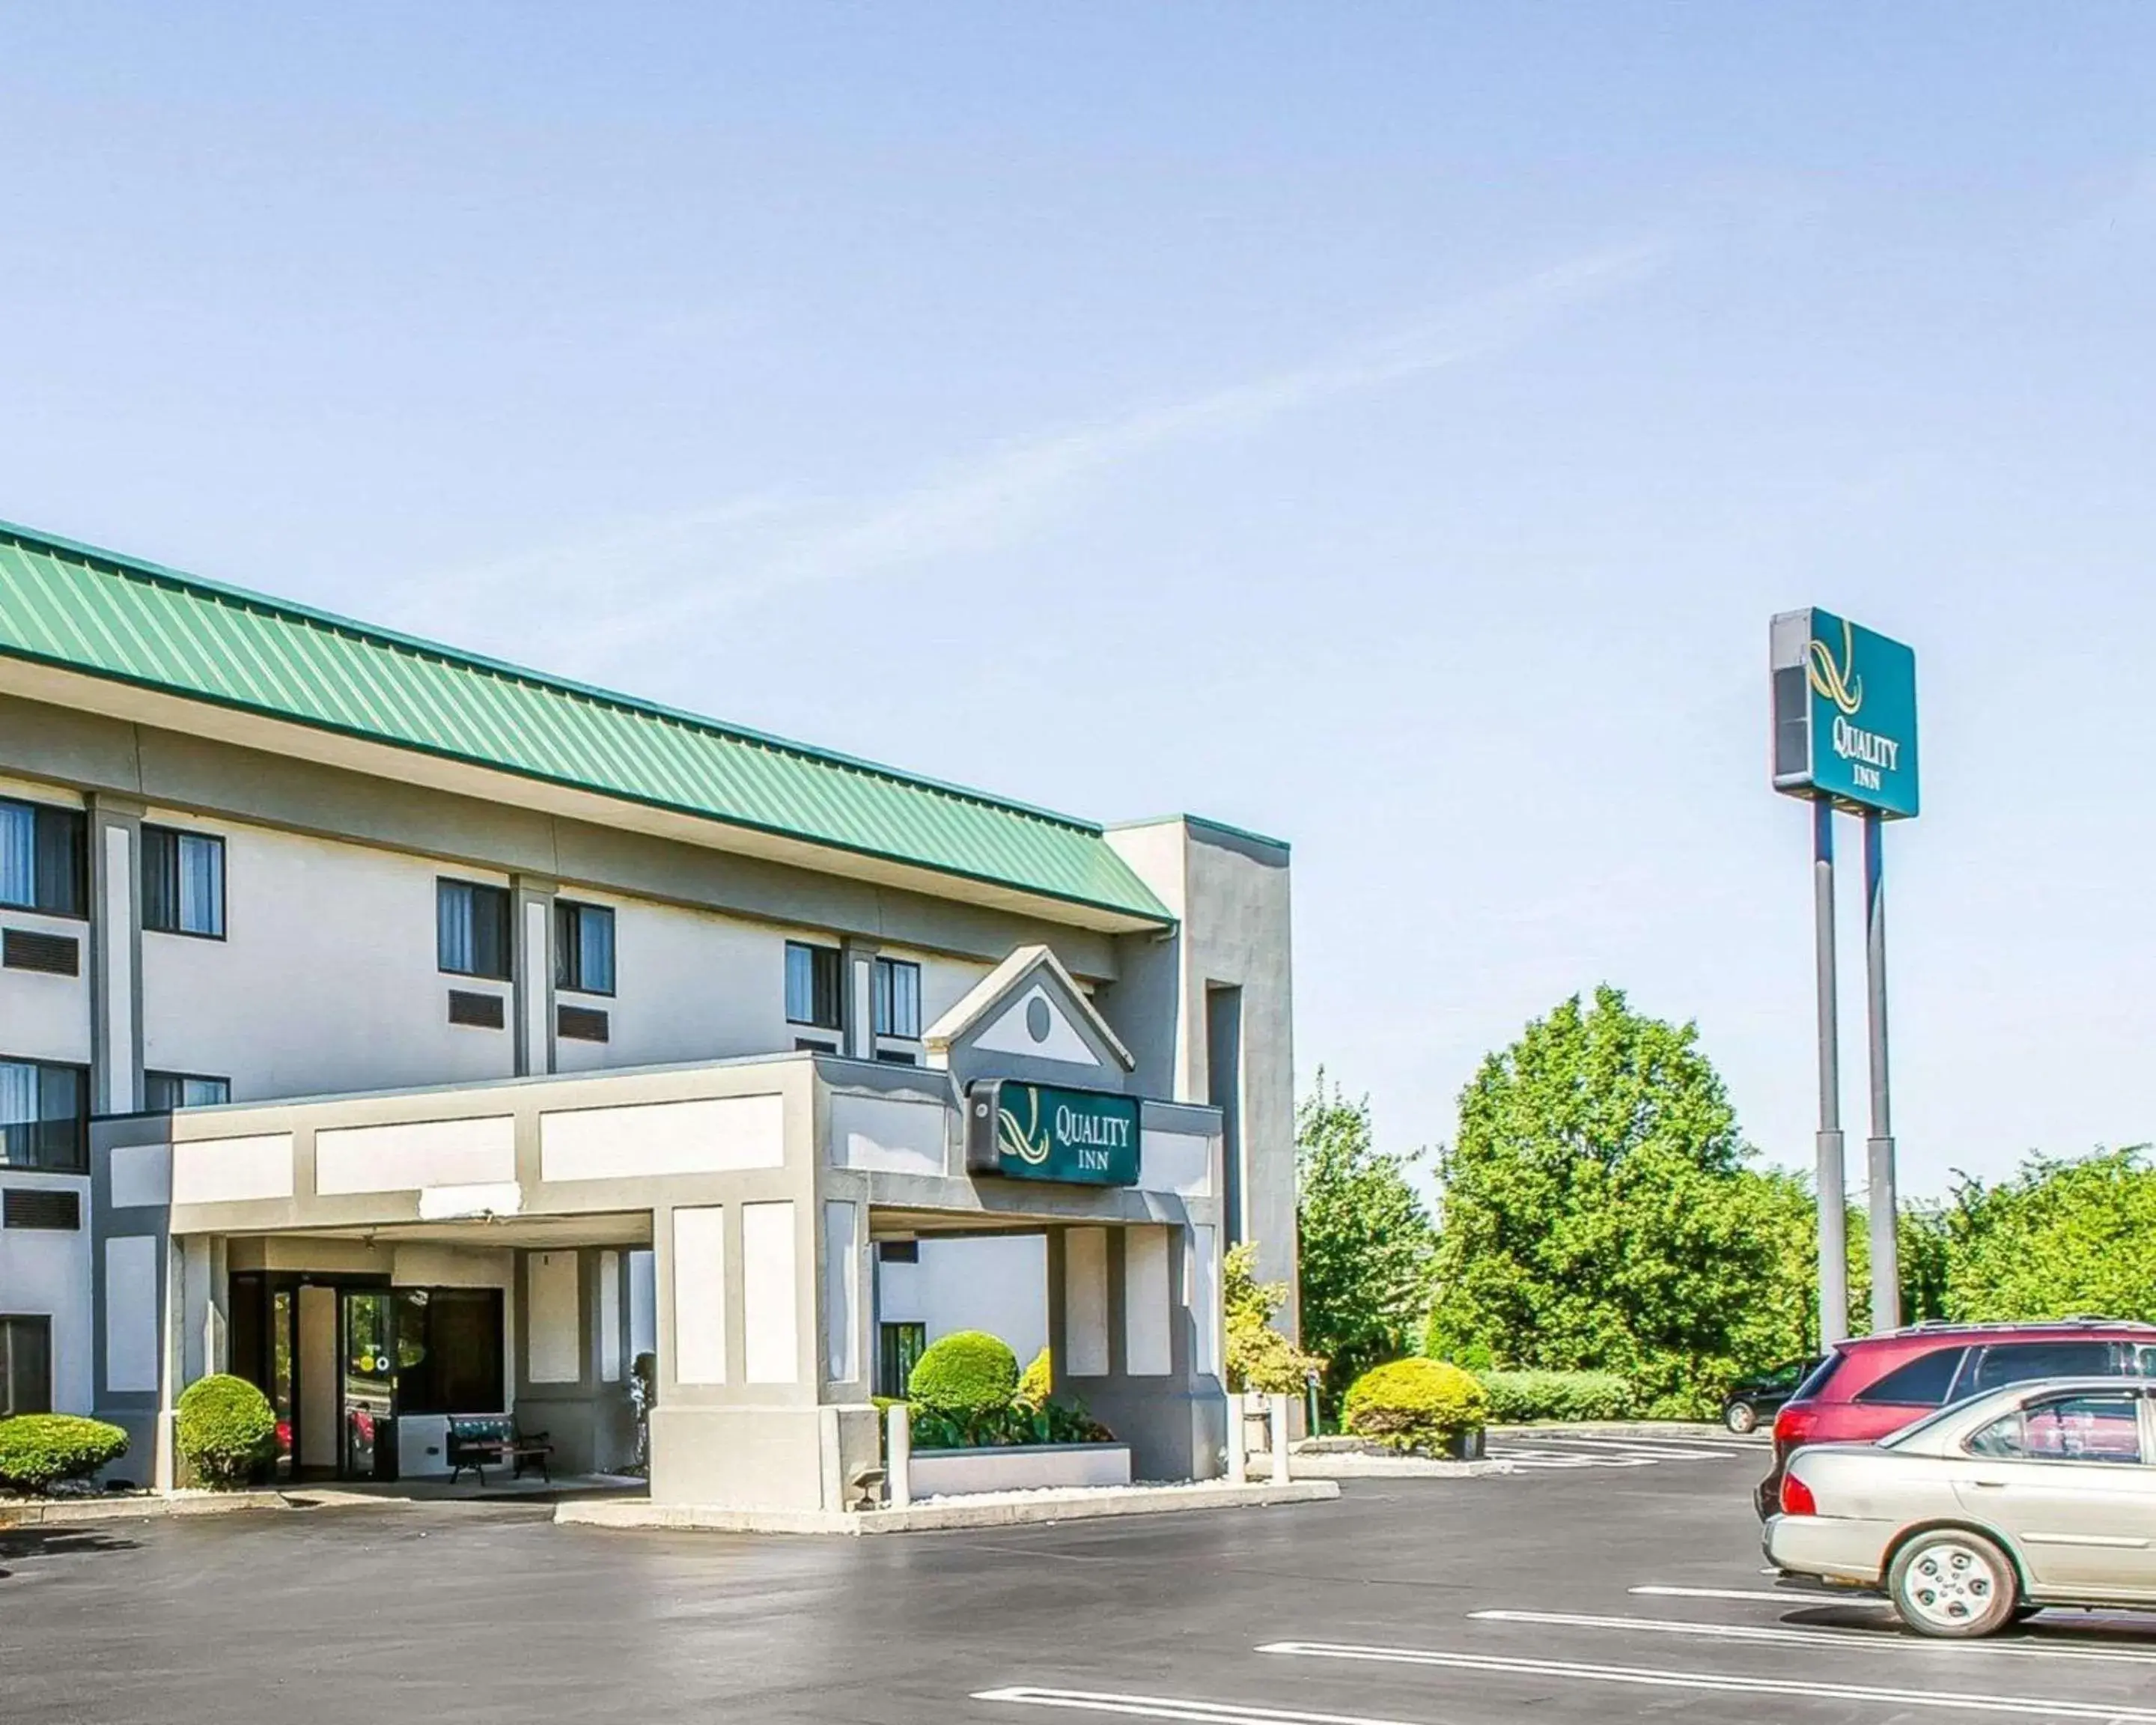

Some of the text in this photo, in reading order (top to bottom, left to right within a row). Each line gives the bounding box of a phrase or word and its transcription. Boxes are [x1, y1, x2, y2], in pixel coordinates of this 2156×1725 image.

[1833, 716, 1898, 770] QUALITY
[1854, 764, 1880, 791] INN
[1056, 1105, 1130, 1147] QUALITY
[1079, 1149, 1109, 1170] INN
